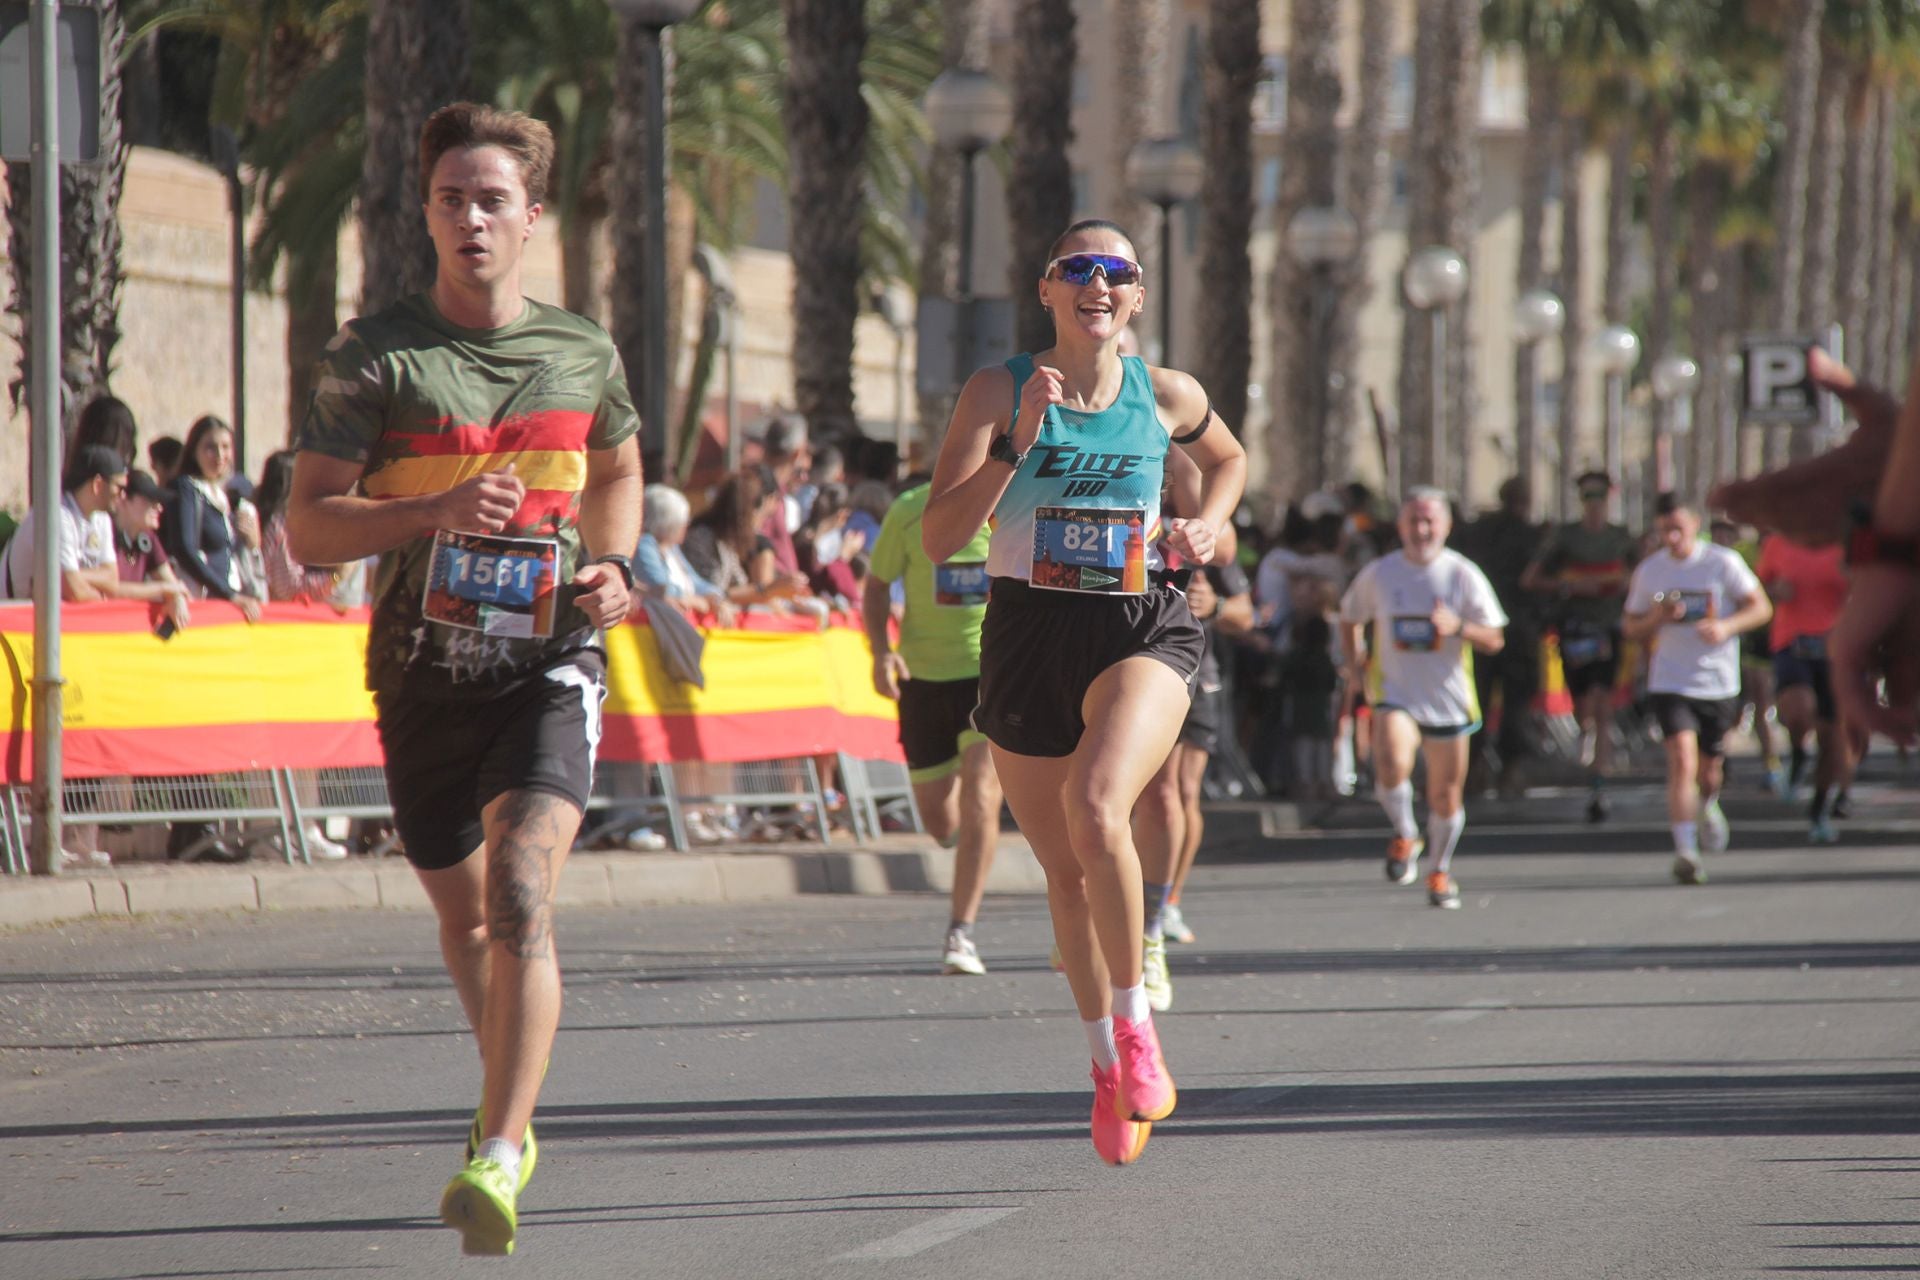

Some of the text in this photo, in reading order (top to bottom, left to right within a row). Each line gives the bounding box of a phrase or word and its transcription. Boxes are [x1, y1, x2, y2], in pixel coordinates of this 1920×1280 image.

[1750, 347, 1806, 409] P
[1061, 480, 1109, 498] 180
[1063, 523, 1114, 553] 821
[455, 553, 530, 589] 1561
